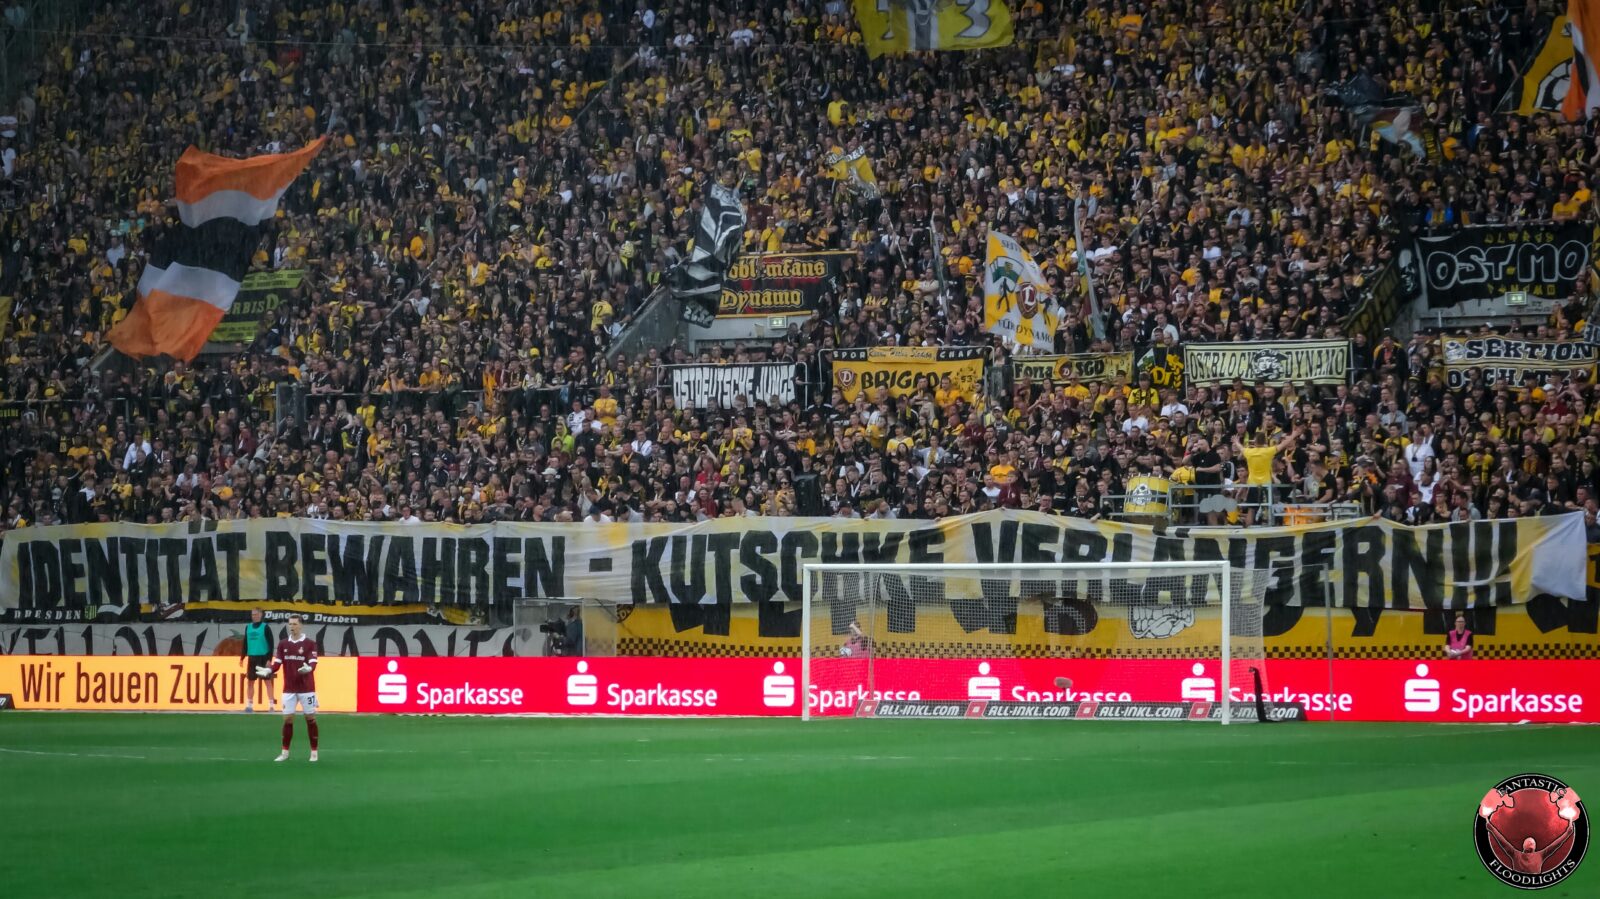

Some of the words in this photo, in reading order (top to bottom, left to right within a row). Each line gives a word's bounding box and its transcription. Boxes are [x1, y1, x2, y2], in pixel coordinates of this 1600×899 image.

[1426, 240, 1593, 290] OSTMO
[1284, 347, 1345, 378] DYNAMO
[1465, 337, 1595, 361] SEKTION
[755, 364, 796, 408] JUNGS
[18, 521, 246, 610] IDENTITÄT
[265, 530, 565, 606] BEWAHREN
[631, 528, 945, 605] KUTSCHKE
[264, 611, 309, 621] Dynao
[314, 613, 359, 624] Dresden
[20, 662, 65, 703] Wir
[76, 661, 158, 704] bauen
[169, 662, 278, 704] Zukun
[416, 682, 524, 710] Sparkasse
[606, 682, 718, 711] Sparkasse
[1011, 685, 1132, 702] Sparkasse
[809, 684, 920, 712] Sparkasse
[1451, 688, 1583, 714] Sparkasse
